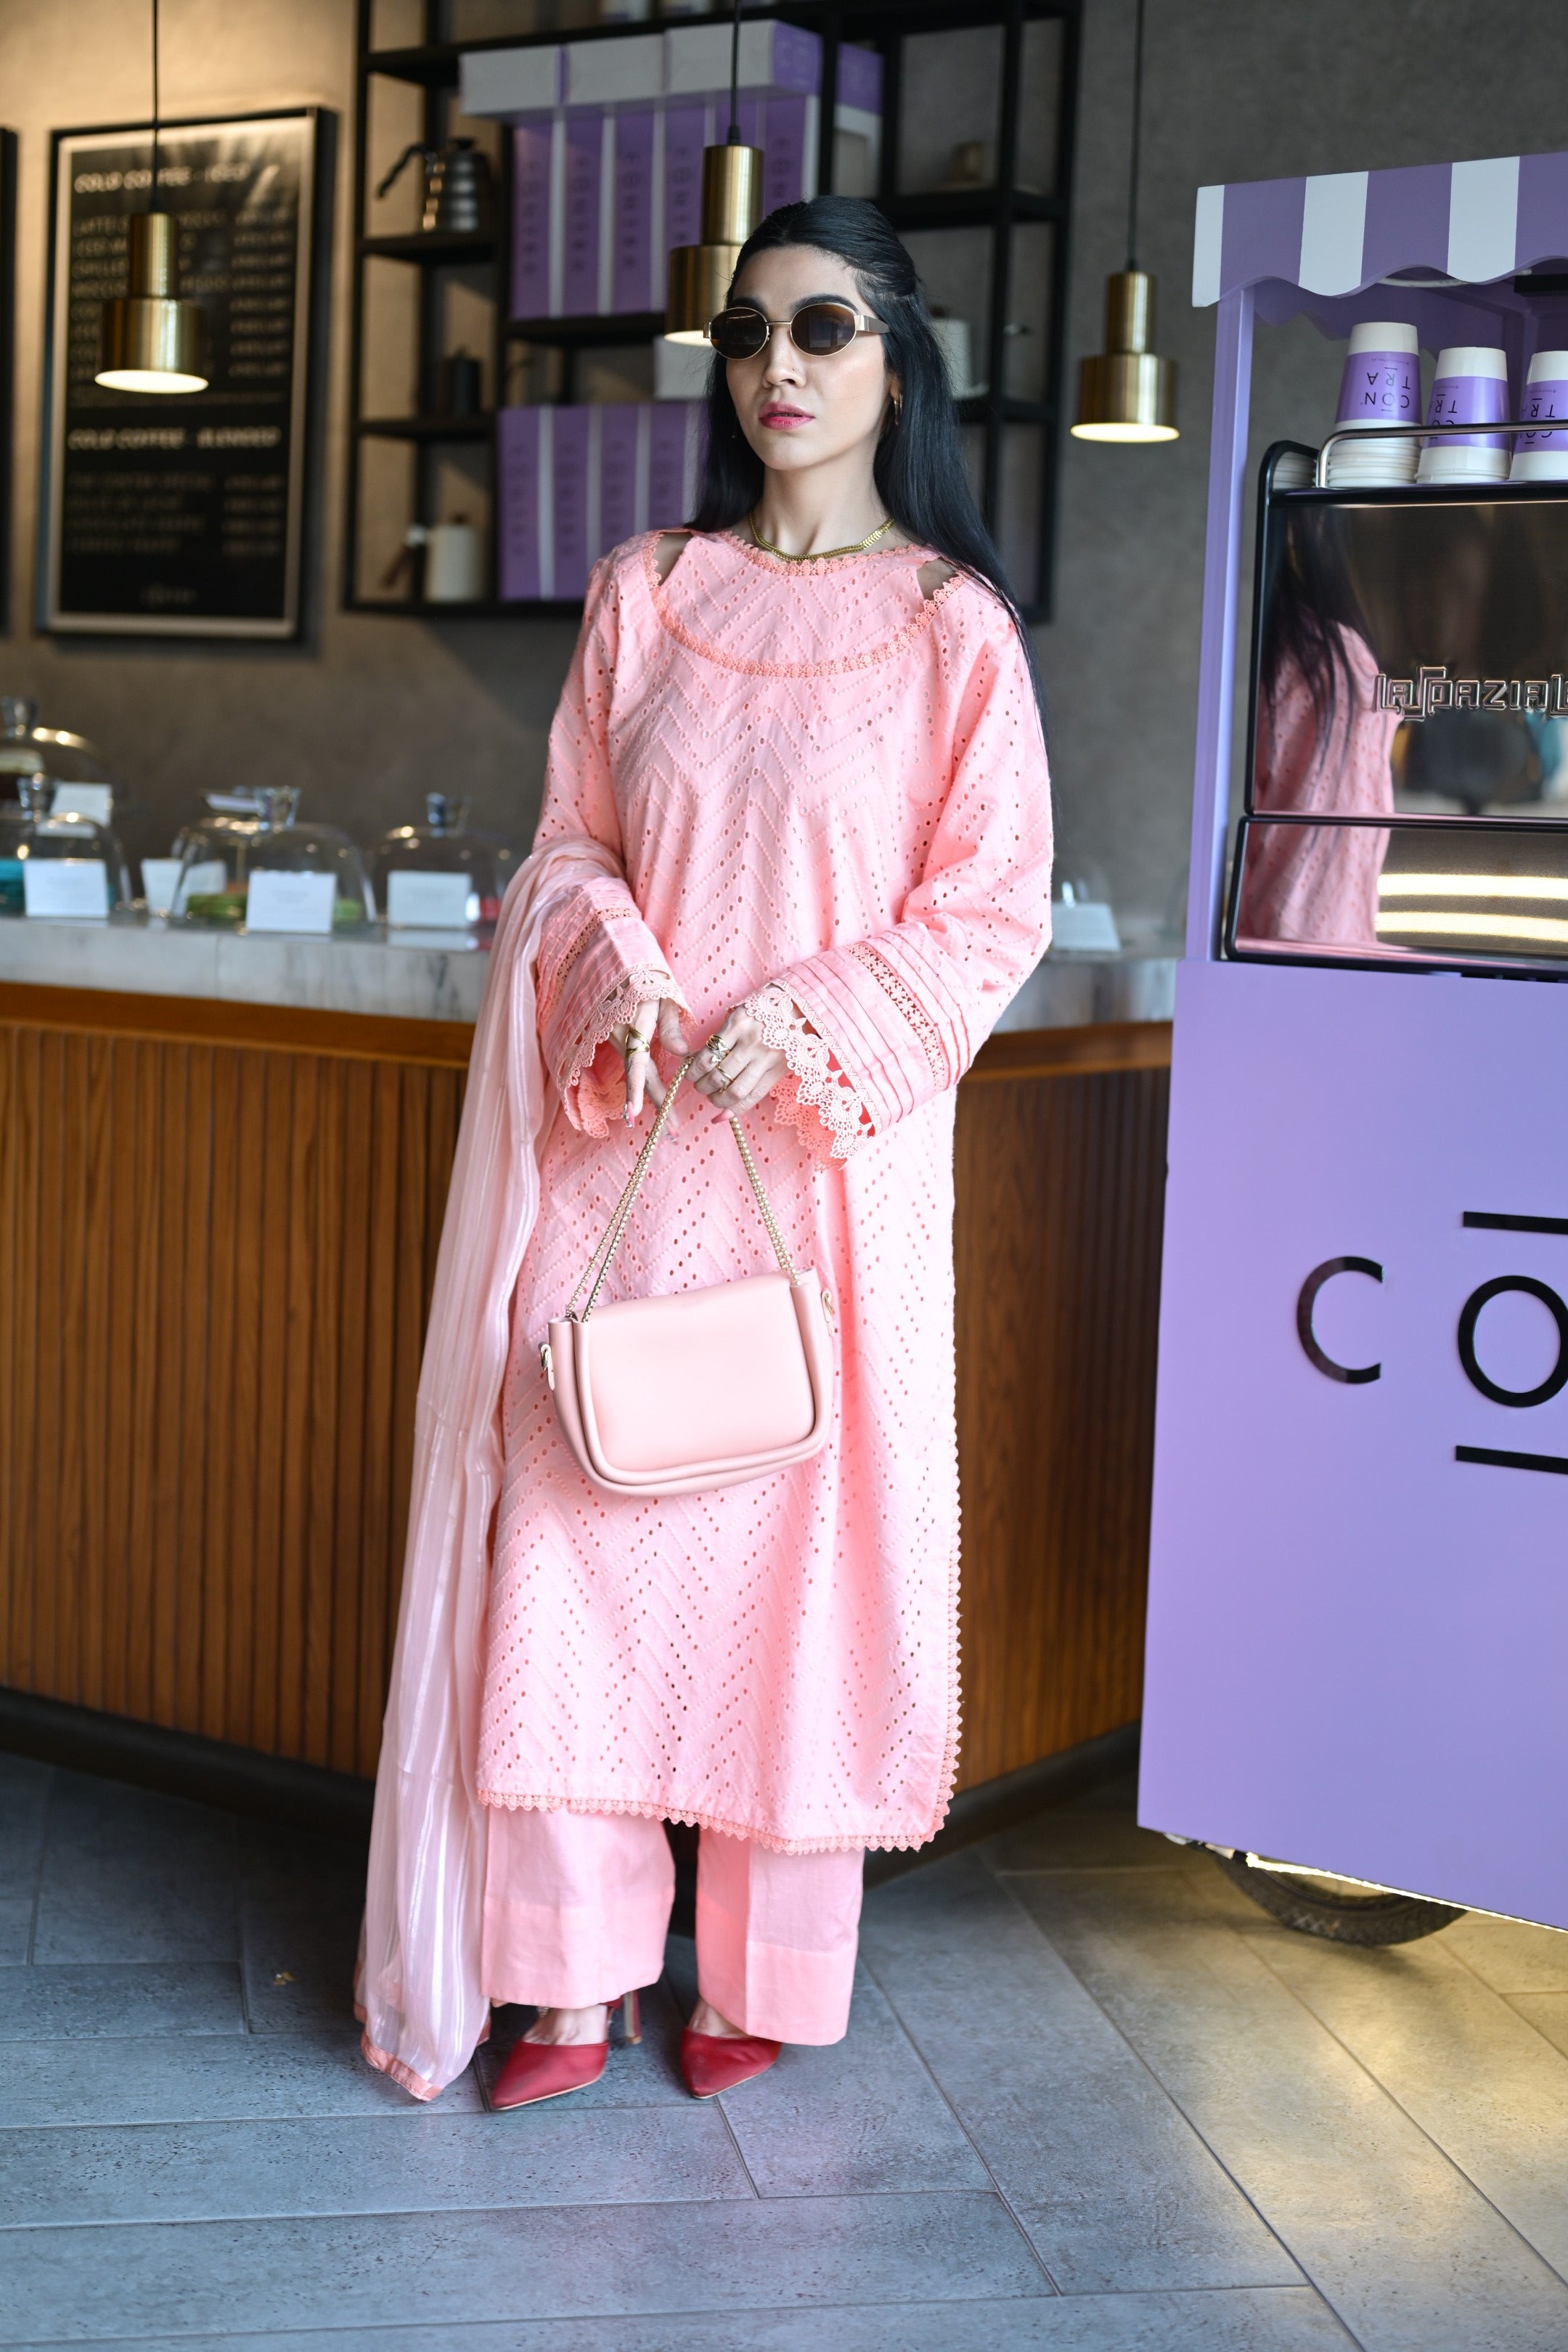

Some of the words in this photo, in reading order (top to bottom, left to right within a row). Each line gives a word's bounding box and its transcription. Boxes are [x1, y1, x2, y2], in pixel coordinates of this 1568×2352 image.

[1366, 372, 1410, 390] TRA
[1364, 391, 1410, 409] CON
[116, 426, 186, 450] COFFEE
